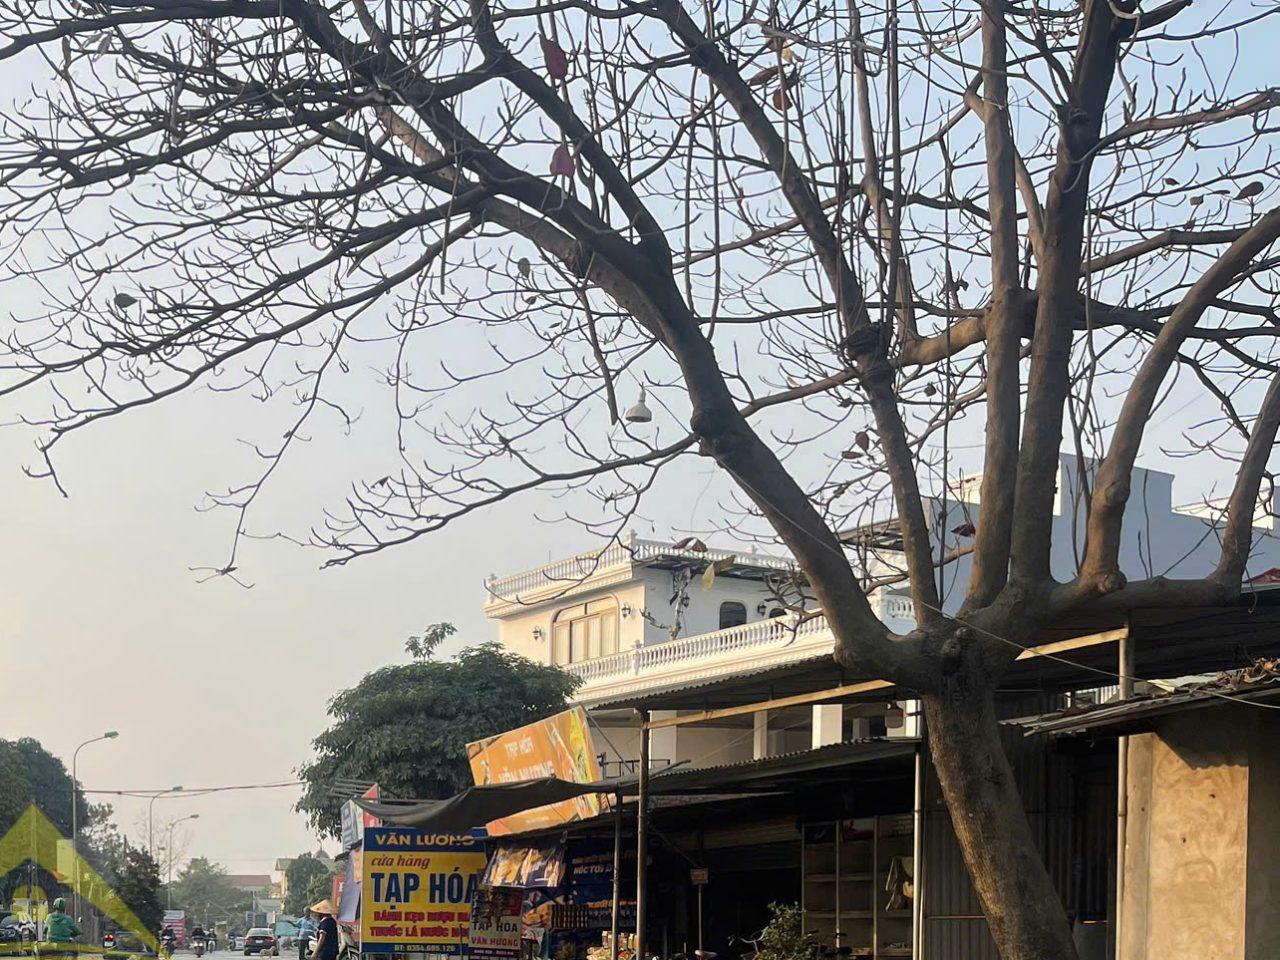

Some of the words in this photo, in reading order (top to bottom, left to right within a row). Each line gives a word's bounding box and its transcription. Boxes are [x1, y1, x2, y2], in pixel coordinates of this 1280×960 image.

[371, 853, 394, 866] cửa
[396, 854, 431, 869] hàng
[371, 872, 420, 909] TẠP
[405, 925, 418, 937] LÁ
